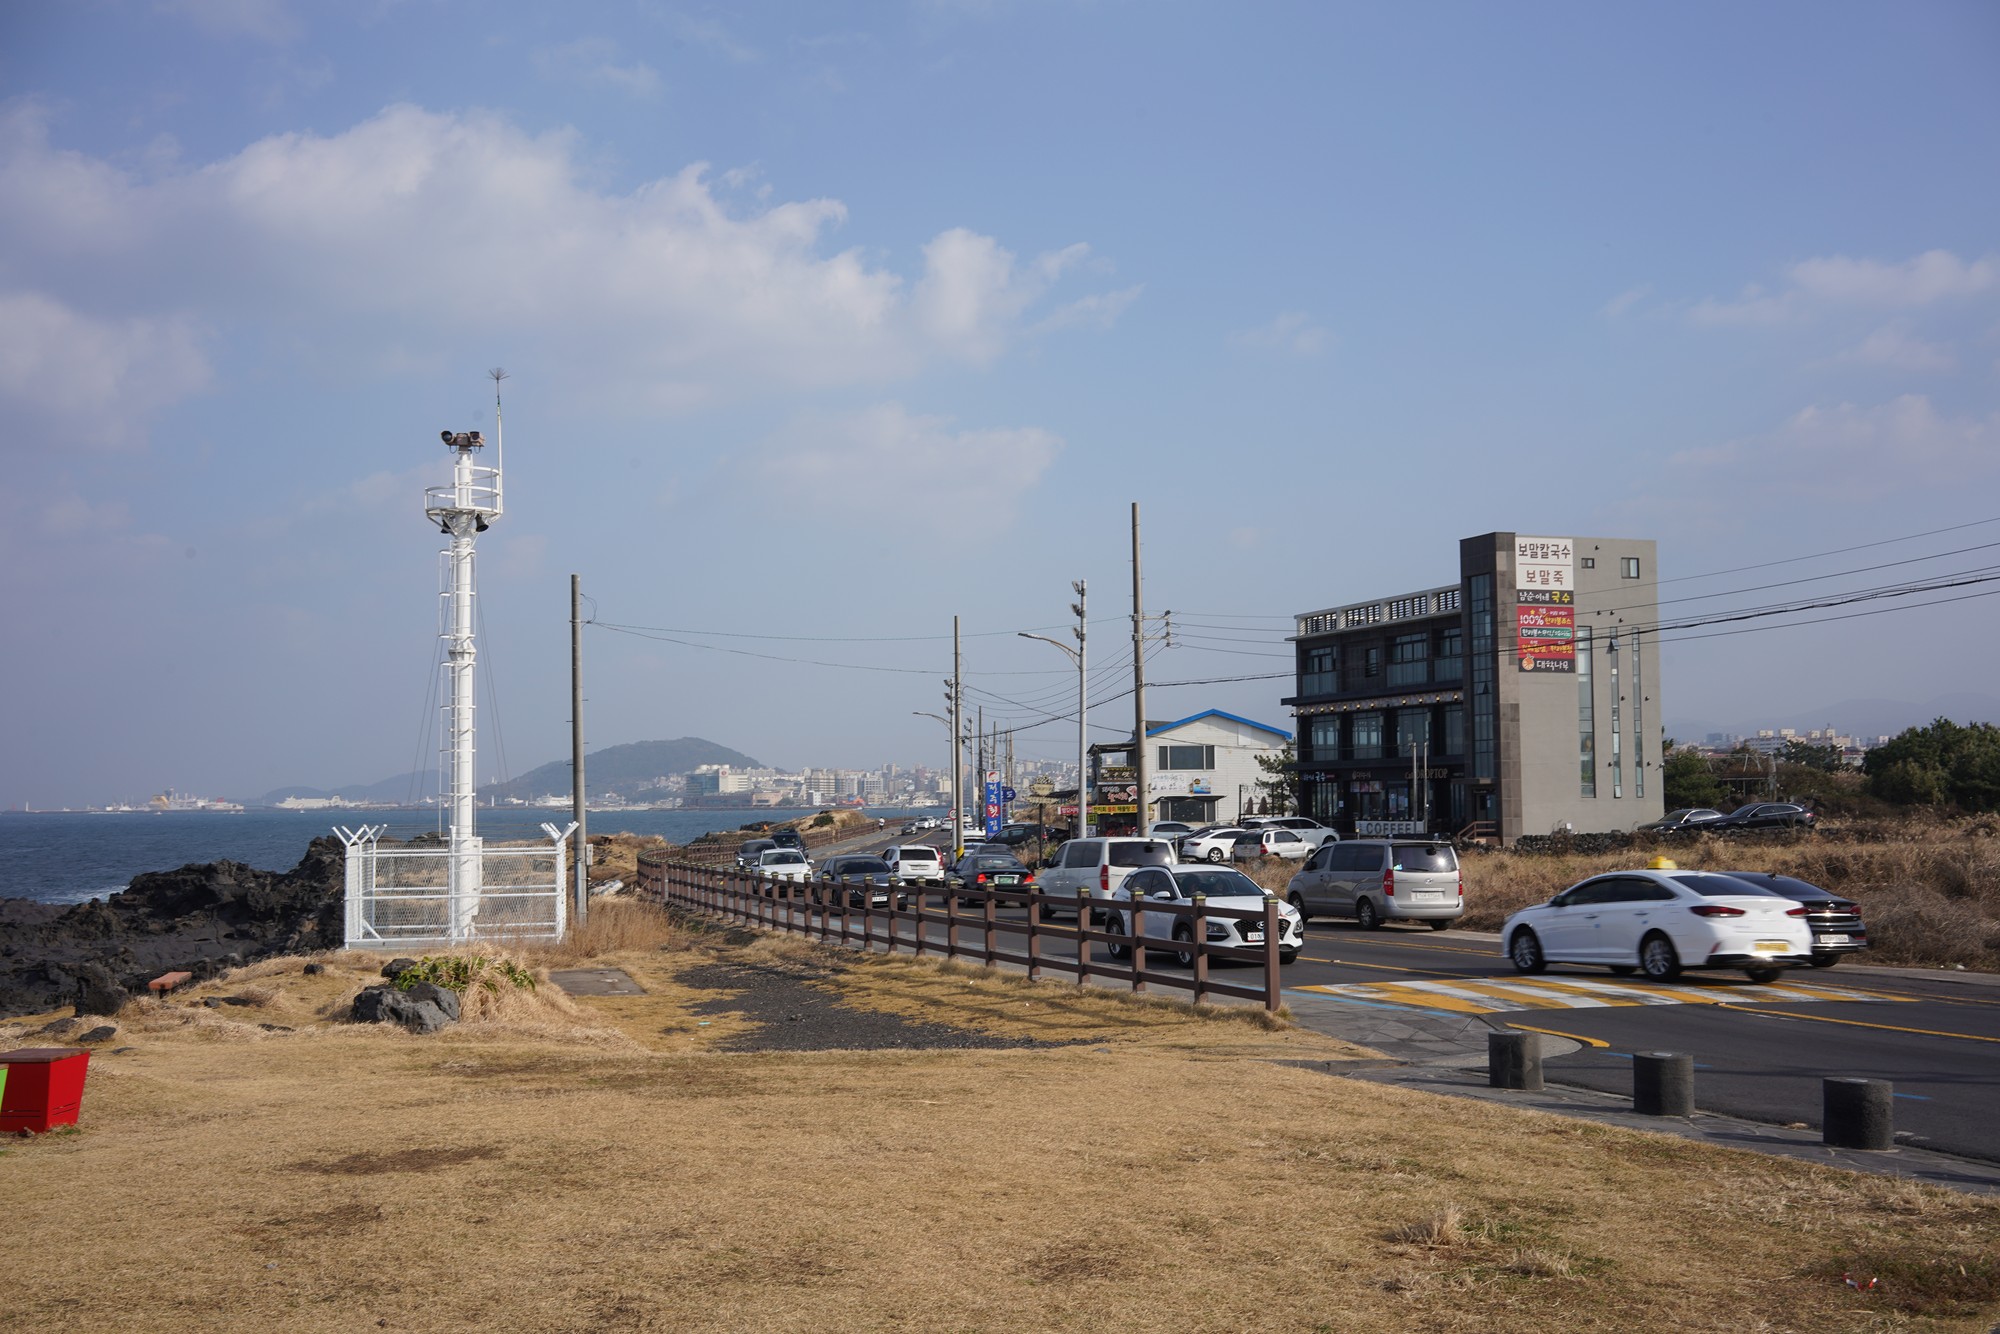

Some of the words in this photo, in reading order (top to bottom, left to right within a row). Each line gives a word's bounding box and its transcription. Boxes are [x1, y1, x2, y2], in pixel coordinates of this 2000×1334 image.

[1518, 543, 1571, 560] 보말칼국수
[1551, 591, 1571, 604] 국수
[1520, 615, 1544, 625] 100%
[1366, 822, 1412, 834] COFFEE
